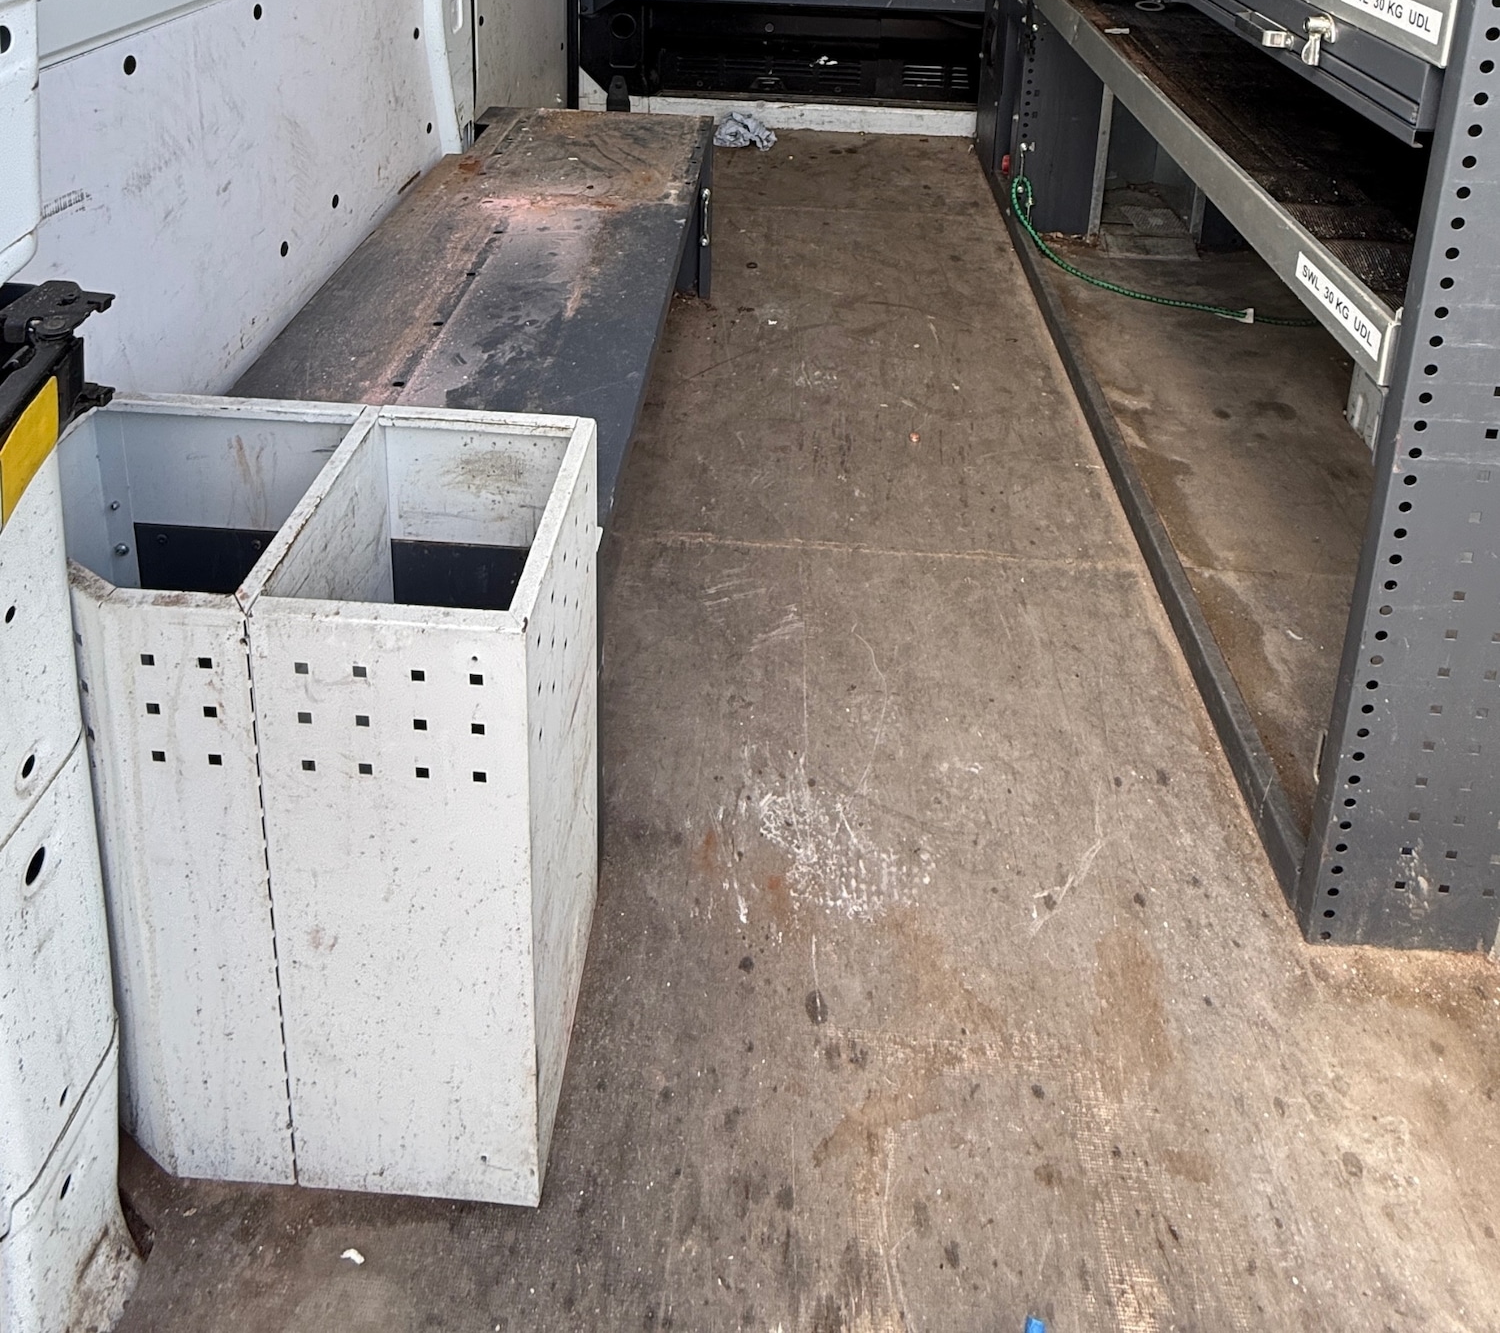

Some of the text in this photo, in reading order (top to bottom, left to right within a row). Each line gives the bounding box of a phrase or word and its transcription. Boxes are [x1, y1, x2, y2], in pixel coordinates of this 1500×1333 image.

[1387, 0, 1403, 19] KG
[1408, 9, 1431, 32] UDL
[1302, 265, 1372, 347] SWL 30 KG UDL
